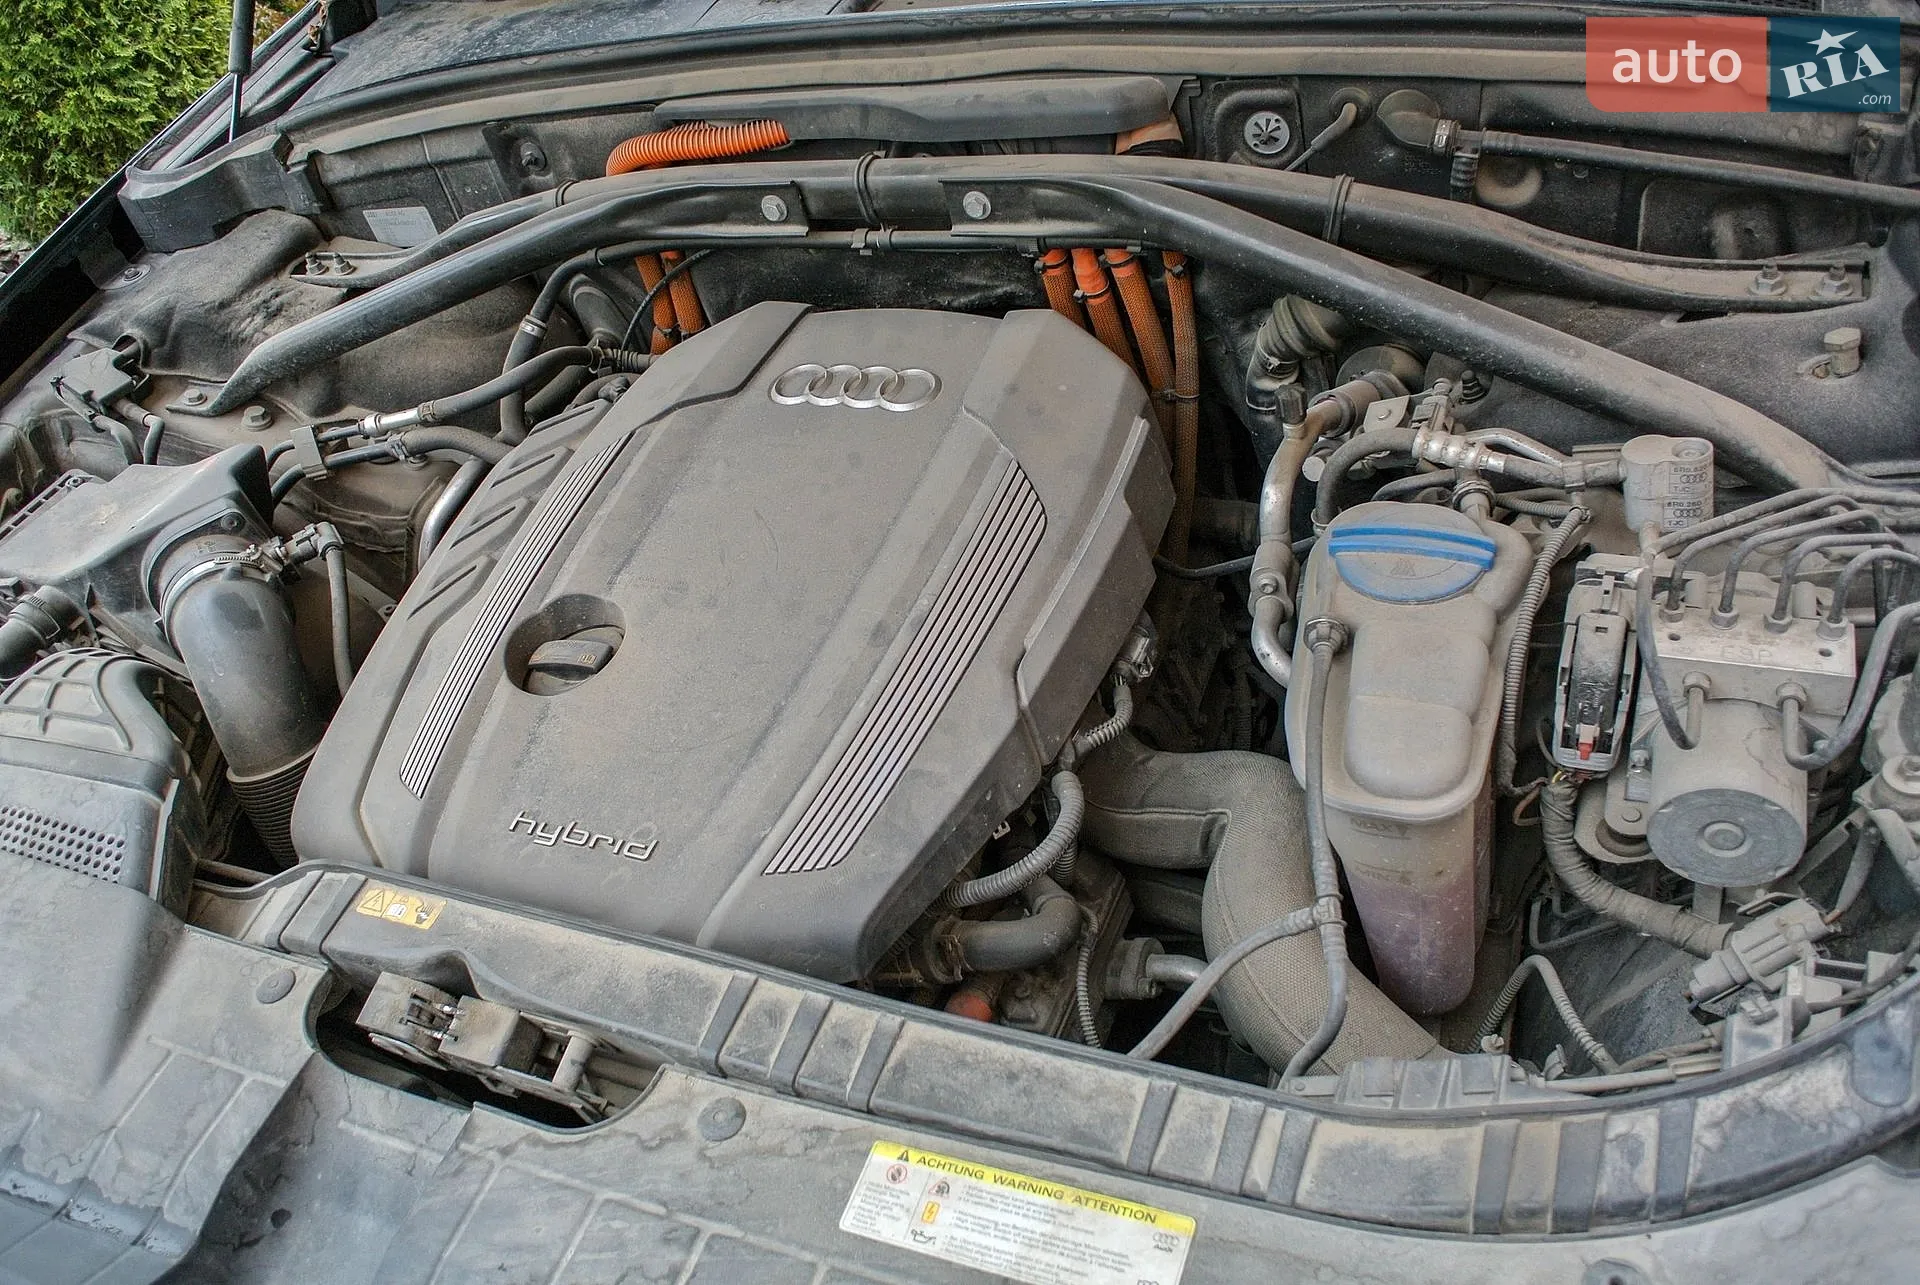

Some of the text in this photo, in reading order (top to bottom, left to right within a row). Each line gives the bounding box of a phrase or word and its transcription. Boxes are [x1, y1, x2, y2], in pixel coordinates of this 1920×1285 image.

[509, 810, 660, 862] hybrid
[916, 1155, 984, 1181] ACHTUNG
[993, 1173, 1065, 1201] WARNING
[1072, 1194, 1158, 1224] ATTENTION
